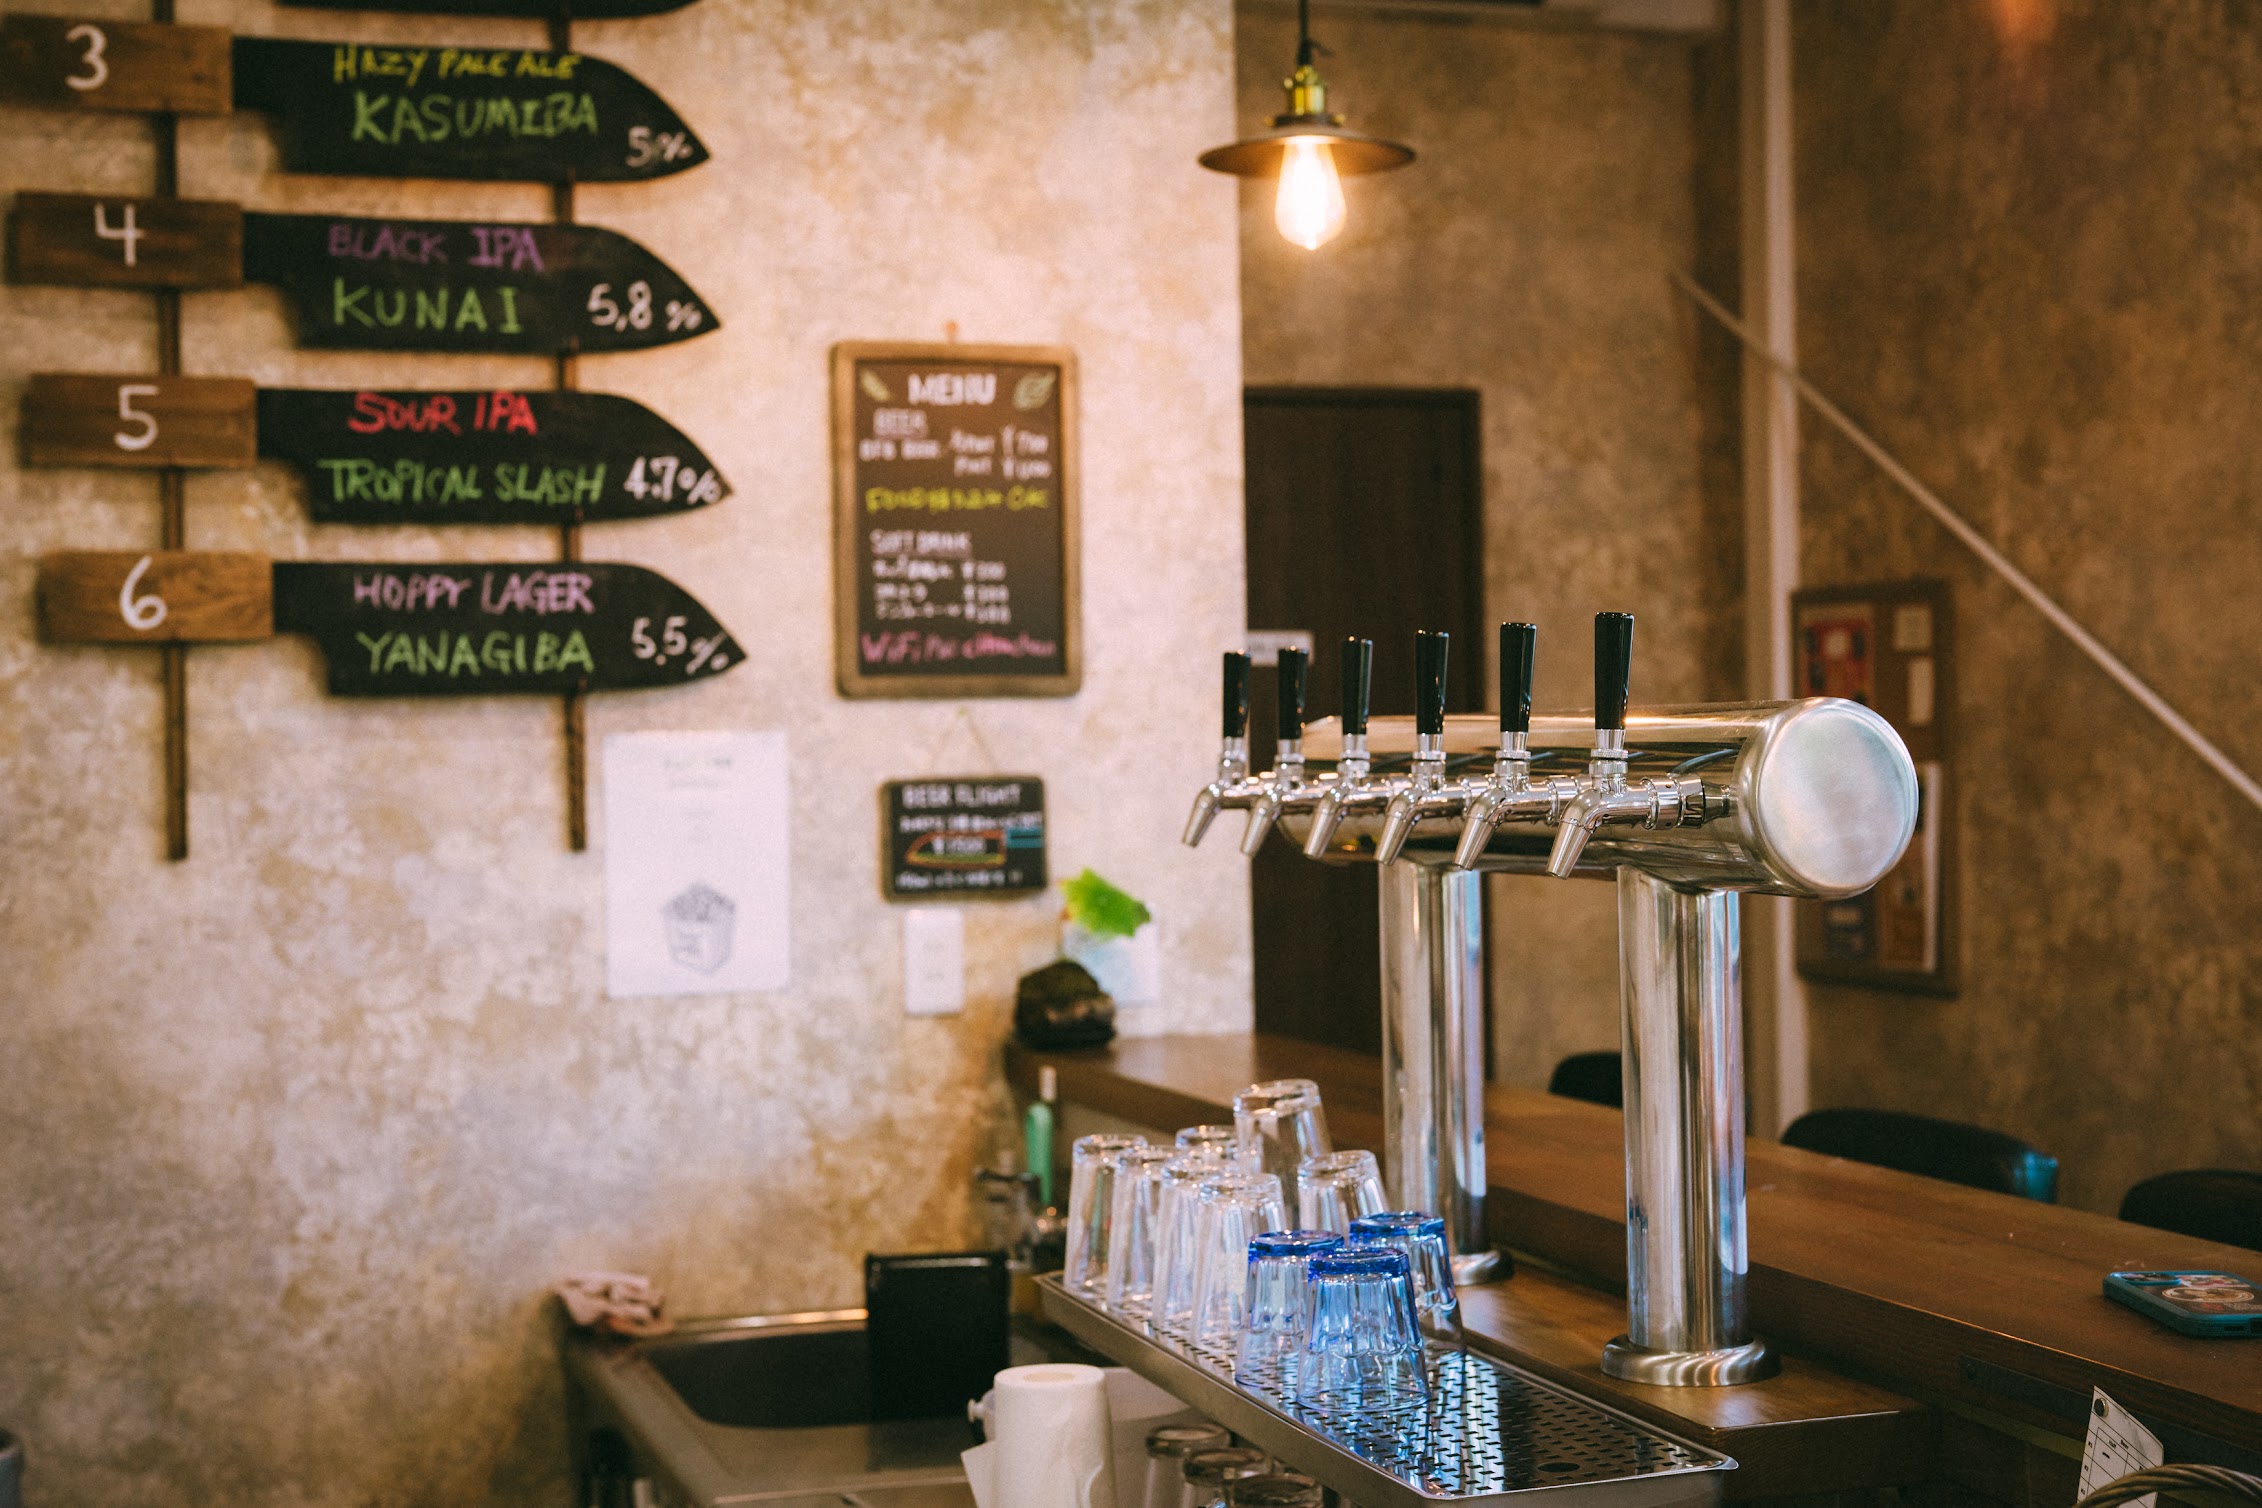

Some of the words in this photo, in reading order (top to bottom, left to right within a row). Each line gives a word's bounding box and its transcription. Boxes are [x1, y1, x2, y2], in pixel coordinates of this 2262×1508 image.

[65, 25, 109, 90] 3
[333, 44, 429, 87] HAZY
[438, 50, 510, 80] PALE
[514, 51, 582, 80] ALE
[351, 89, 598, 143] KASUMIBA
[625, 126, 694, 168] 5%
[95, 203, 145, 267] 4
[326, 222, 448, 266] BLACK
[468, 227, 545, 273] IPA
[333, 276, 523, 335] KUNAI
[347, 391, 462, 437] SOUR
[473, 391, 539, 437] IPA
[908, 373, 997, 405] MENU
[114, 384, 161, 450] 5
[316, 457, 483, 505] TROPICAL
[494, 462, 608, 503] SLASH
[118, 556, 168, 630] 6
[353, 571, 473, 613] HOPPY
[480, 570, 596, 616] LAGER
[355, 629, 596, 678] YANAGIBA
